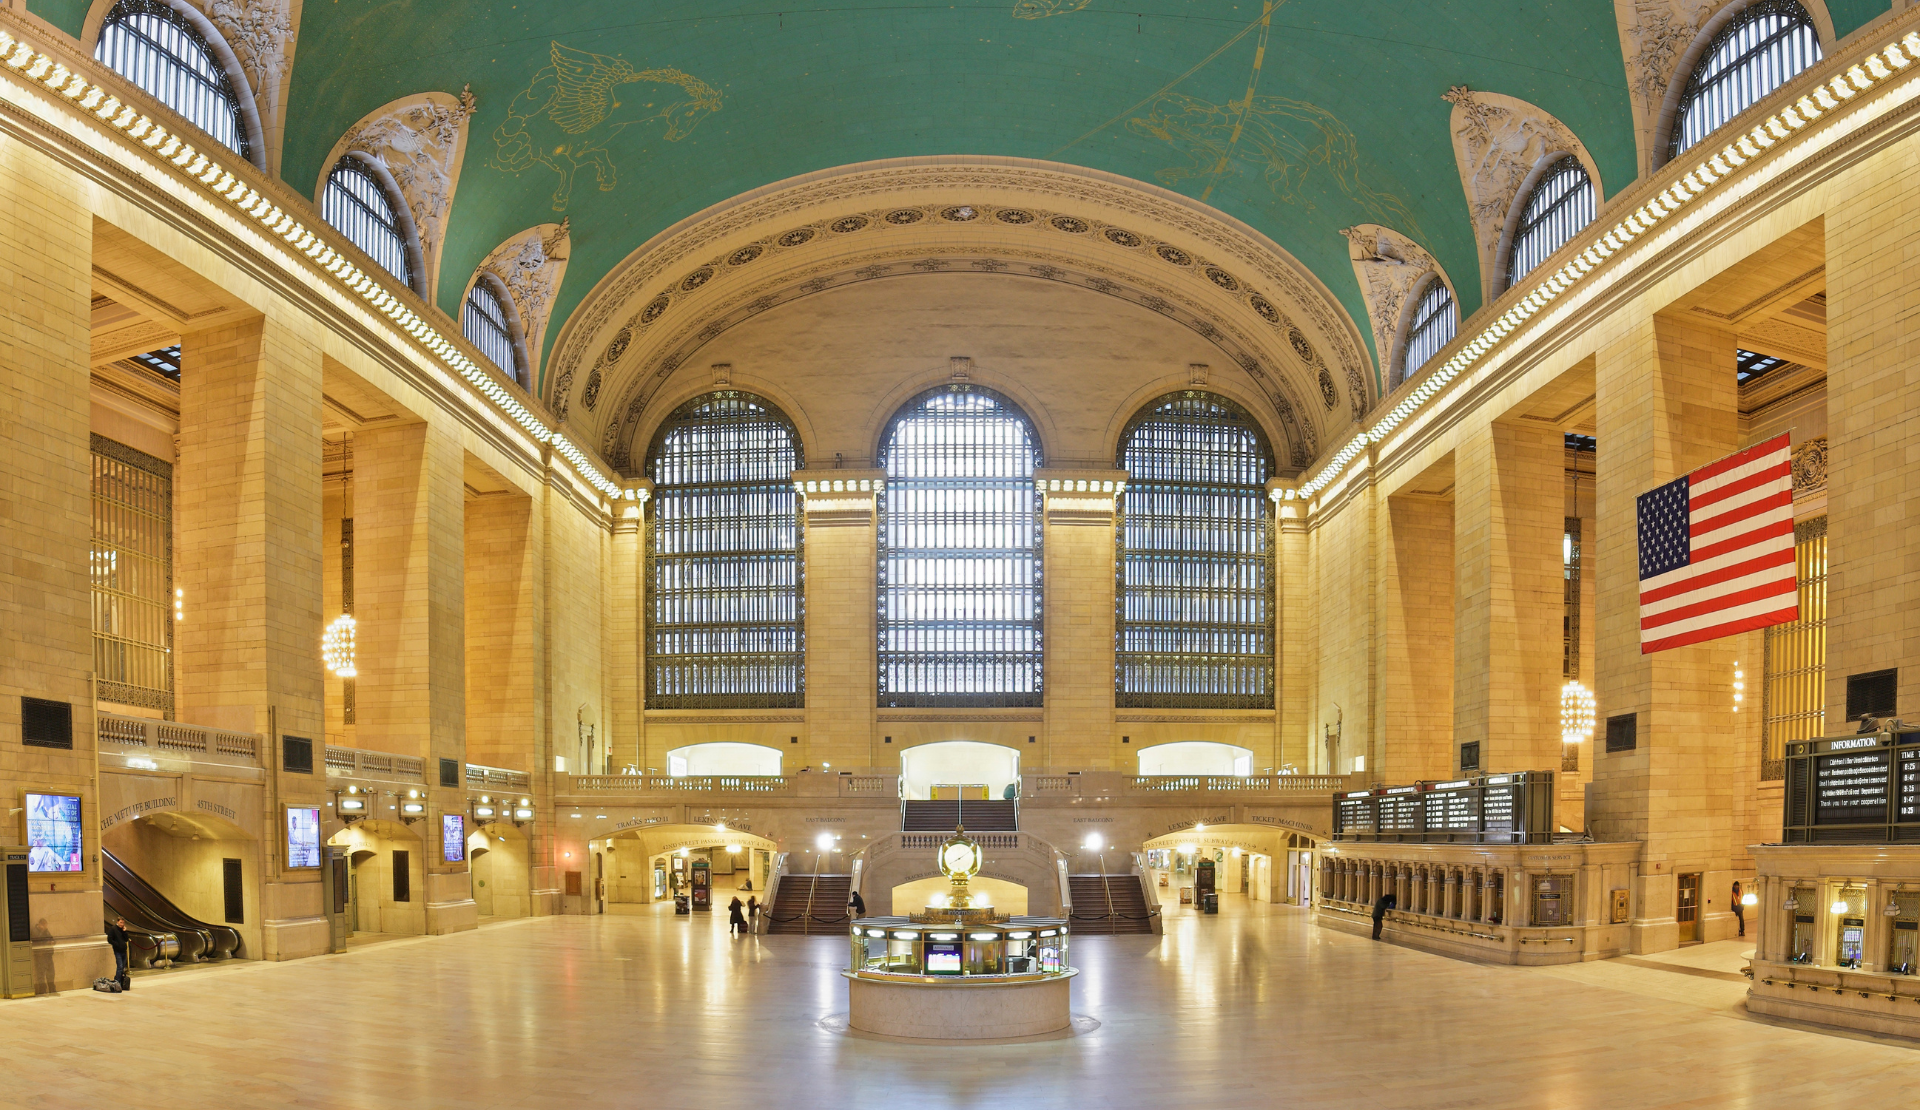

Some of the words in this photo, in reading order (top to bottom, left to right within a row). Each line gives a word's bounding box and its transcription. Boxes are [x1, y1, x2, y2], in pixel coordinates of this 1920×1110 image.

[1831, 737, 1876, 750] INFORMATION
[1901, 751, 1914, 759] TIME
[100, 816, 114, 831] THE
[144, 797, 176, 811] BUILDING
[197, 799, 213, 811] 45TH
[213, 803, 236, 819] STREET
[616, 818, 642, 829] TRACKS
[693, 816, 737, 828] LEXINGON
[738, 823, 753, 831] AVE
[1168, 817, 1211, 831] LEXINGON
[1252, 815, 1276, 823] TICKET
[1278, 818, 1313, 831] MACHINES
[1150, 839, 1174, 847] STREET
[904, 873, 923, 881] TRACKS
[994, 872, 1024, 884] CONCOURSE
